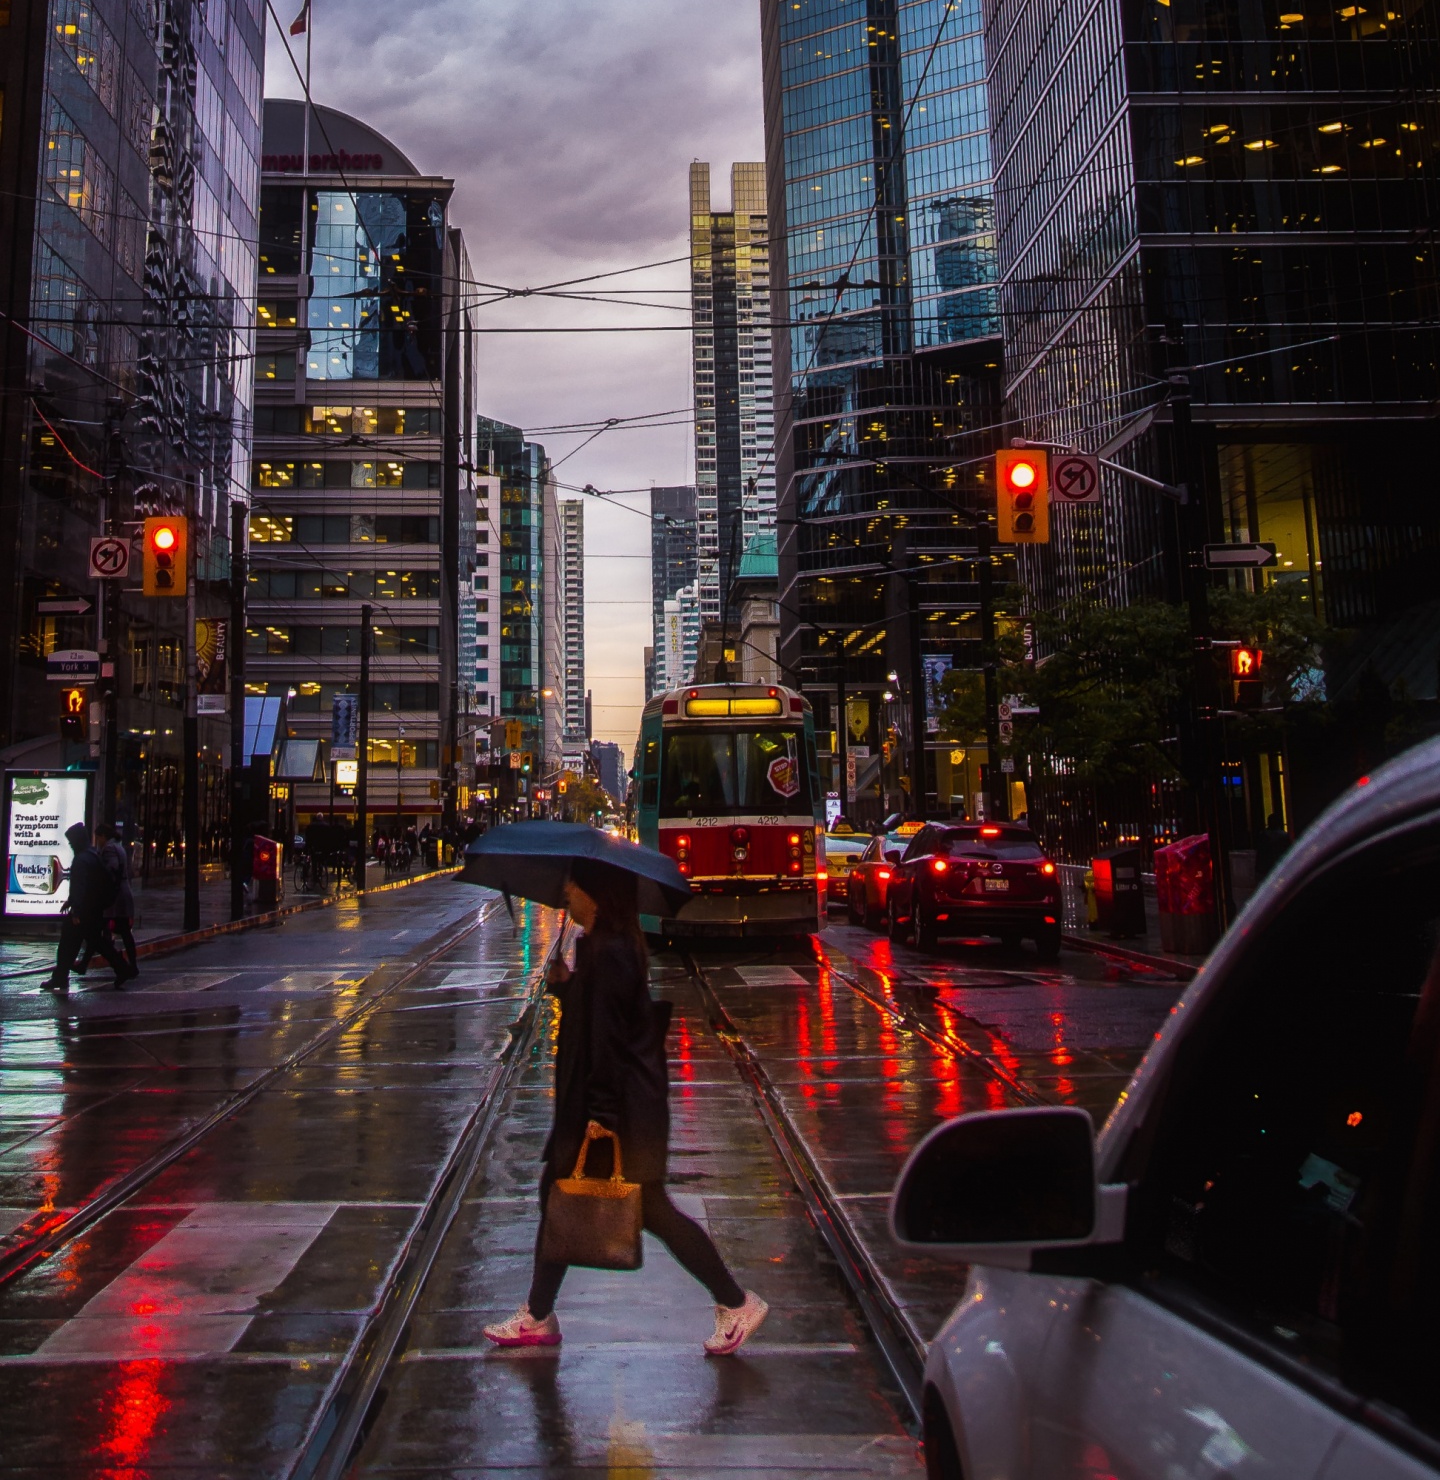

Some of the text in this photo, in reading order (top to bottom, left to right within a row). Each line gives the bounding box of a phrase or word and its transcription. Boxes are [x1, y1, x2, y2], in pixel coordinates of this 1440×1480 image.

[215, 622, 226, 660] BEAUTY
[61, 662, 79, 671] York
[696, 818, 718, 826] 4212
[757, 816, 779, 825] 4212
[14, 823, 59, 831] symptoms
[17, 864, 52, 875] Buckley's
